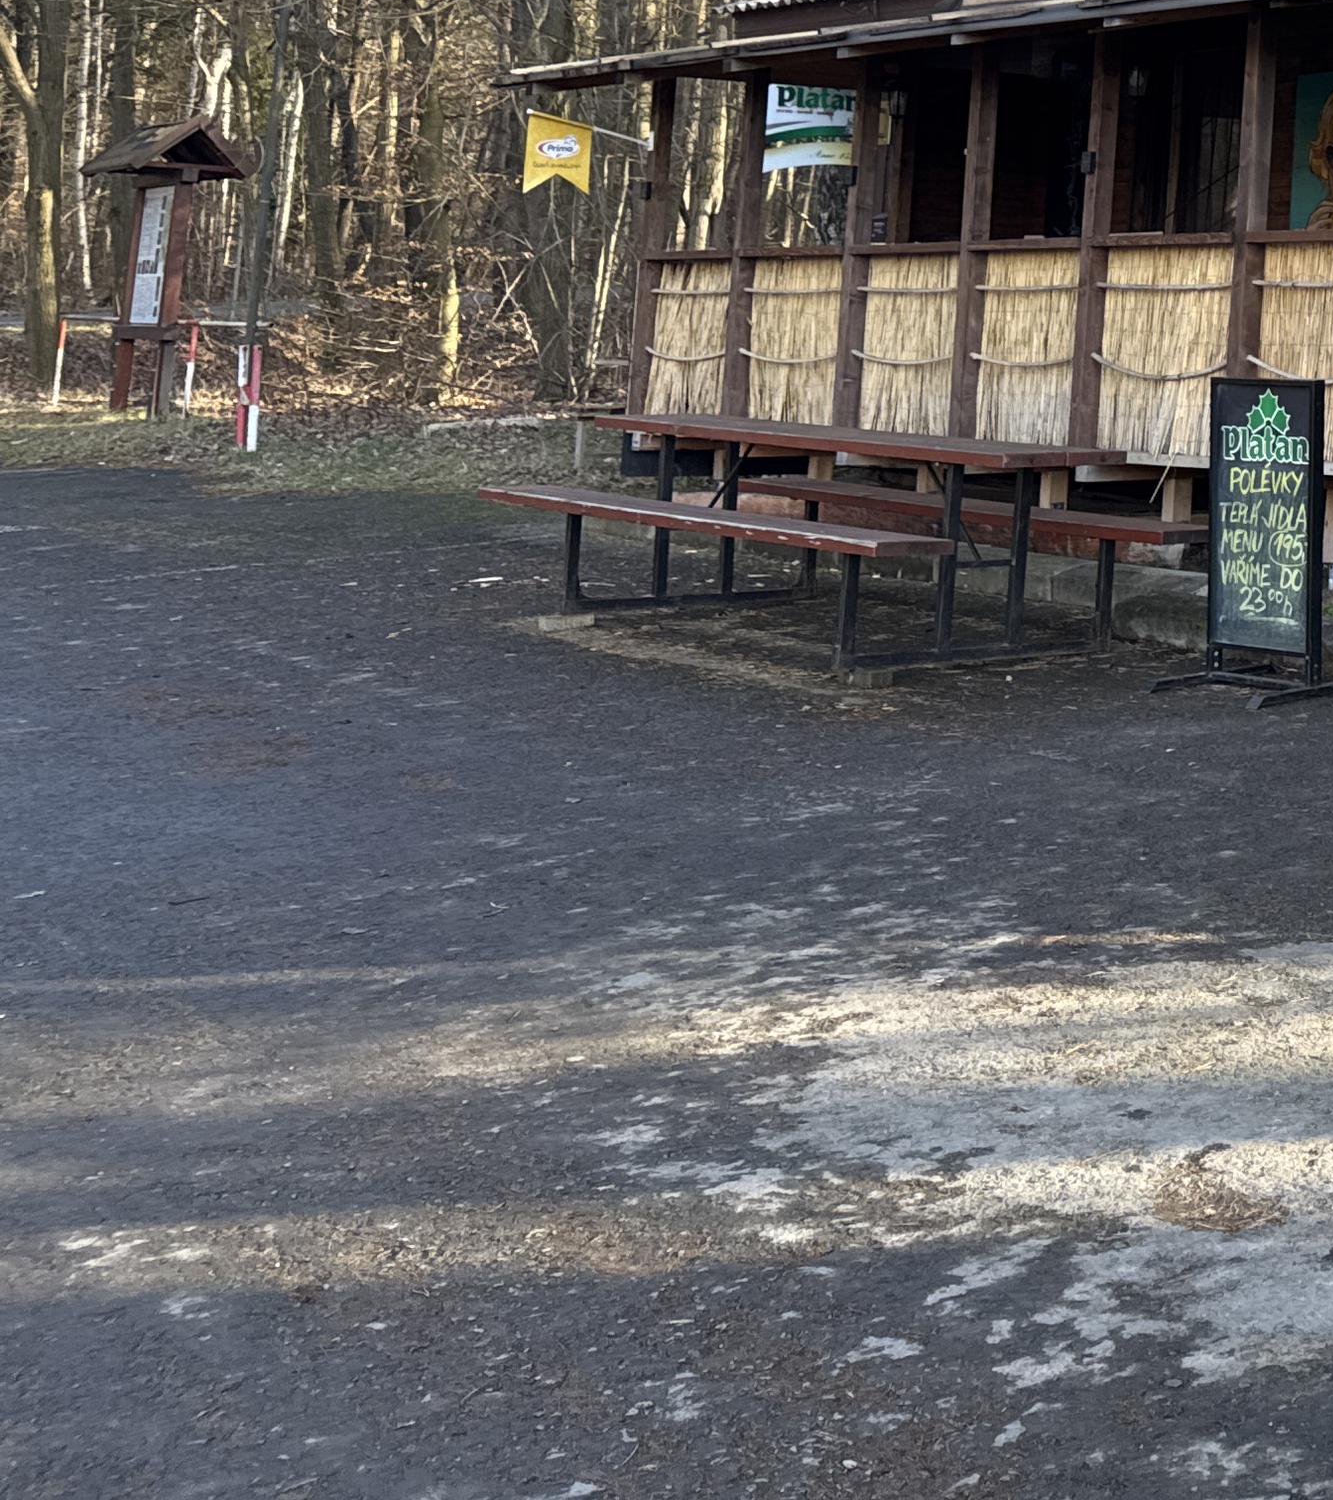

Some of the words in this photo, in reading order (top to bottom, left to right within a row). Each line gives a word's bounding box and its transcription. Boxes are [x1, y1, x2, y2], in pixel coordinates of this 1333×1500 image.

[1221, 425, 1310, 465] Platan
[1229, 462, 1304, 497] POLÉVKY
[1219, 499, 1263, 527] TEPLÁ
[1261, 498, 1307, 533] JÍDLA
[1220, 528, 1264, 555] MENU
[1220, 553, 1272, 589] VAŘÍME
[1280, 566, 1304, 592] DO
